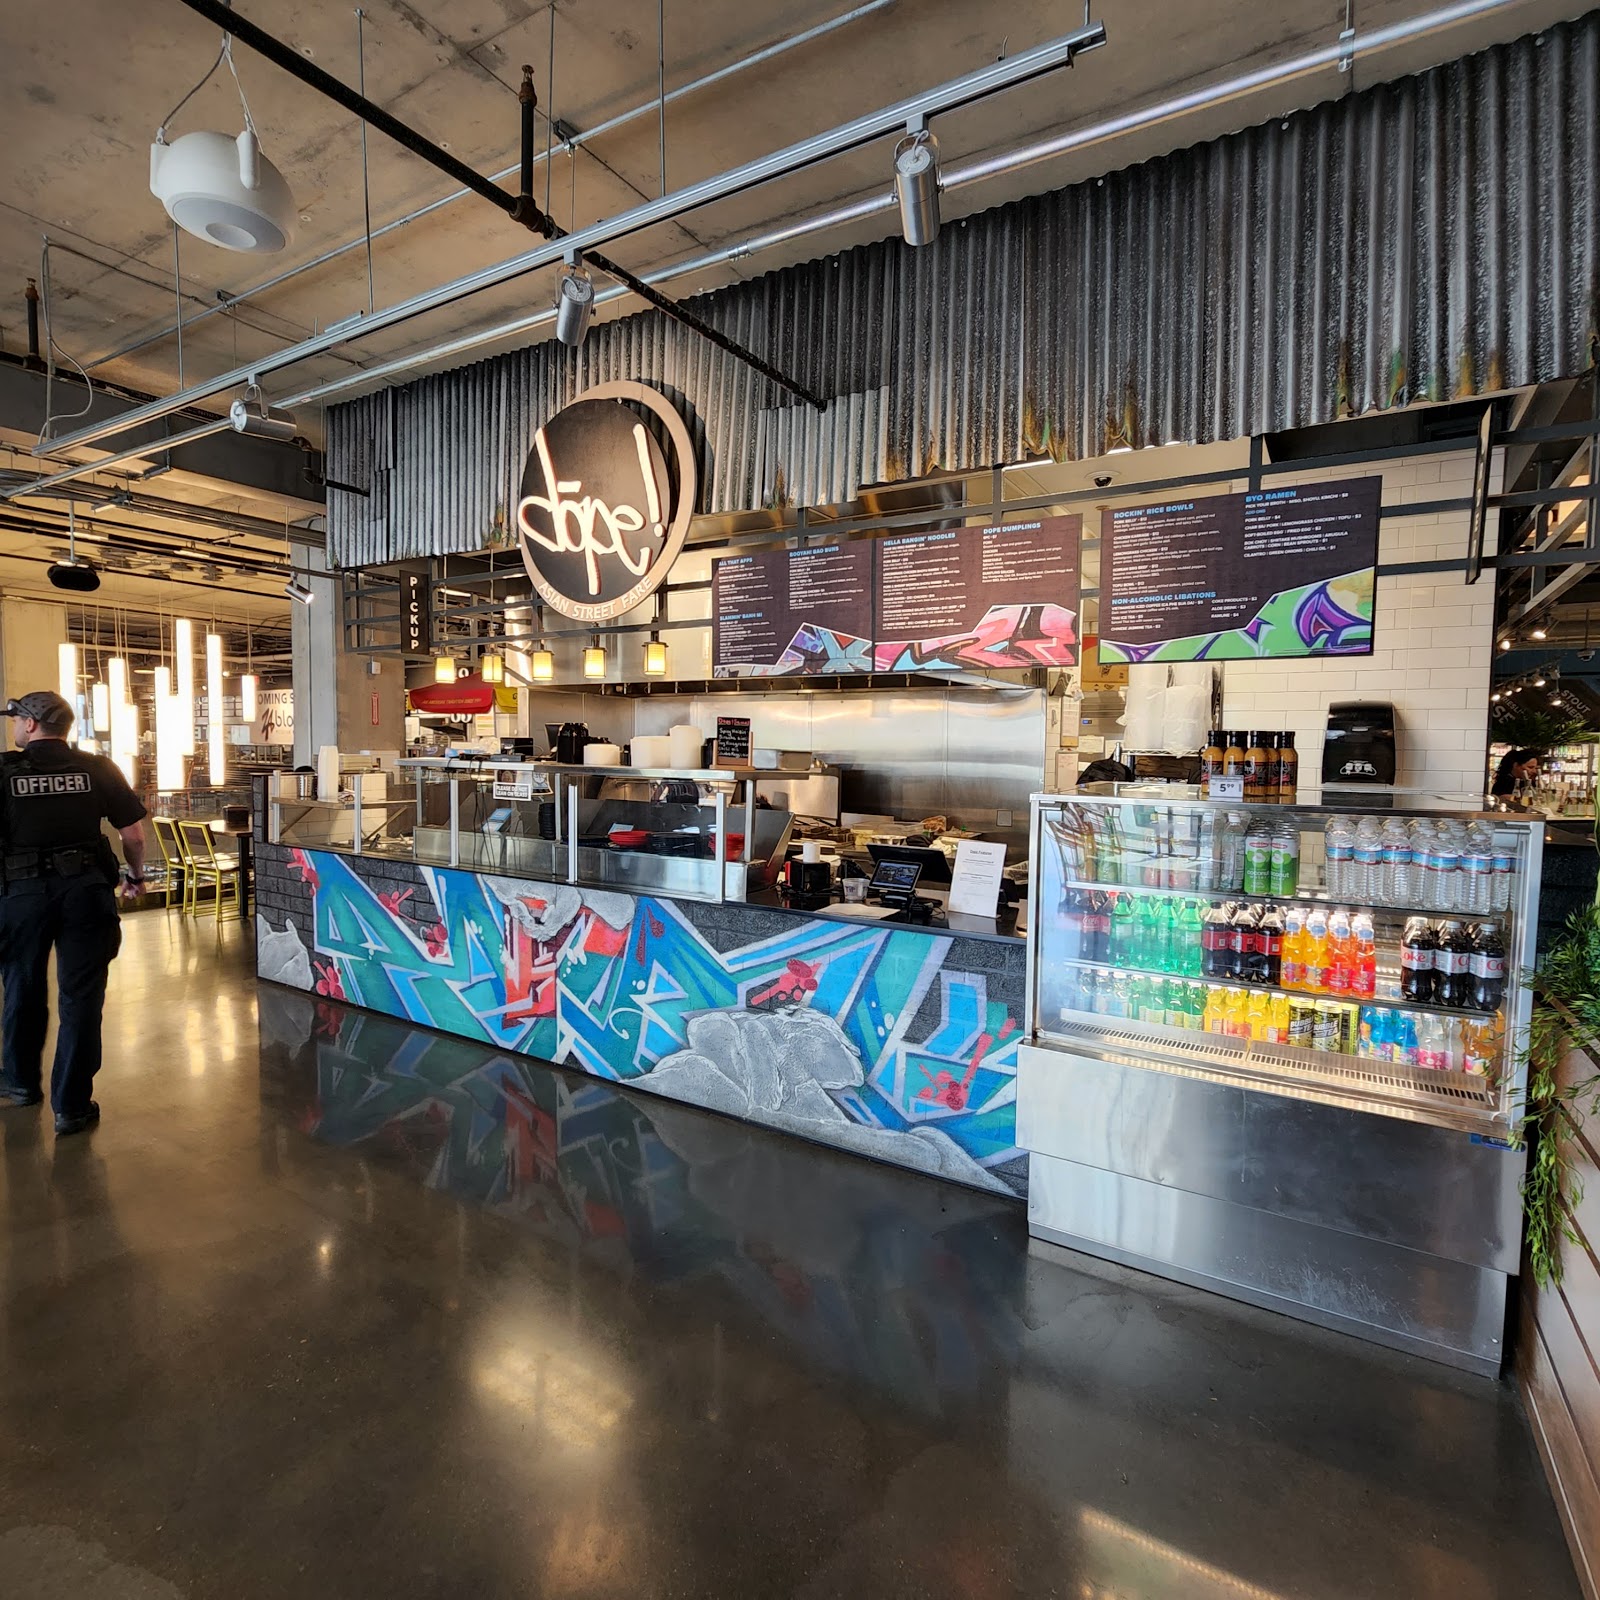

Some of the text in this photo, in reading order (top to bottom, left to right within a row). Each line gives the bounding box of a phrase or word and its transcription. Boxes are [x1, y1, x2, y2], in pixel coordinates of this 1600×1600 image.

[1245, 491, 1297, 503] BYO RAMEN
[1114, 503, 1194, 519] ROCKIN' RICE BOWLS
[1002, 522, 1041, 532] DUMPLINGS
[1281, 519, 1313, 527] LEMONGRASS
[927, 532, 956, 541] NOODLES
[1291, 533, 1322, 541] MUSHROOMS
[538, 577, 653, 620] ASIAN STREET FARE
[1112, 592, 1216, 605] NON-ALCOHOLIC LIBATIONS
[409, 576, 420, 650] PICKUP
[257, 693, 287, 704] OMING
[1561, 689, 1592, 714] STOUT
[16, 775, 86, 794] OFFICER
[1290, 1016, 1314, 1028] BUBBL
